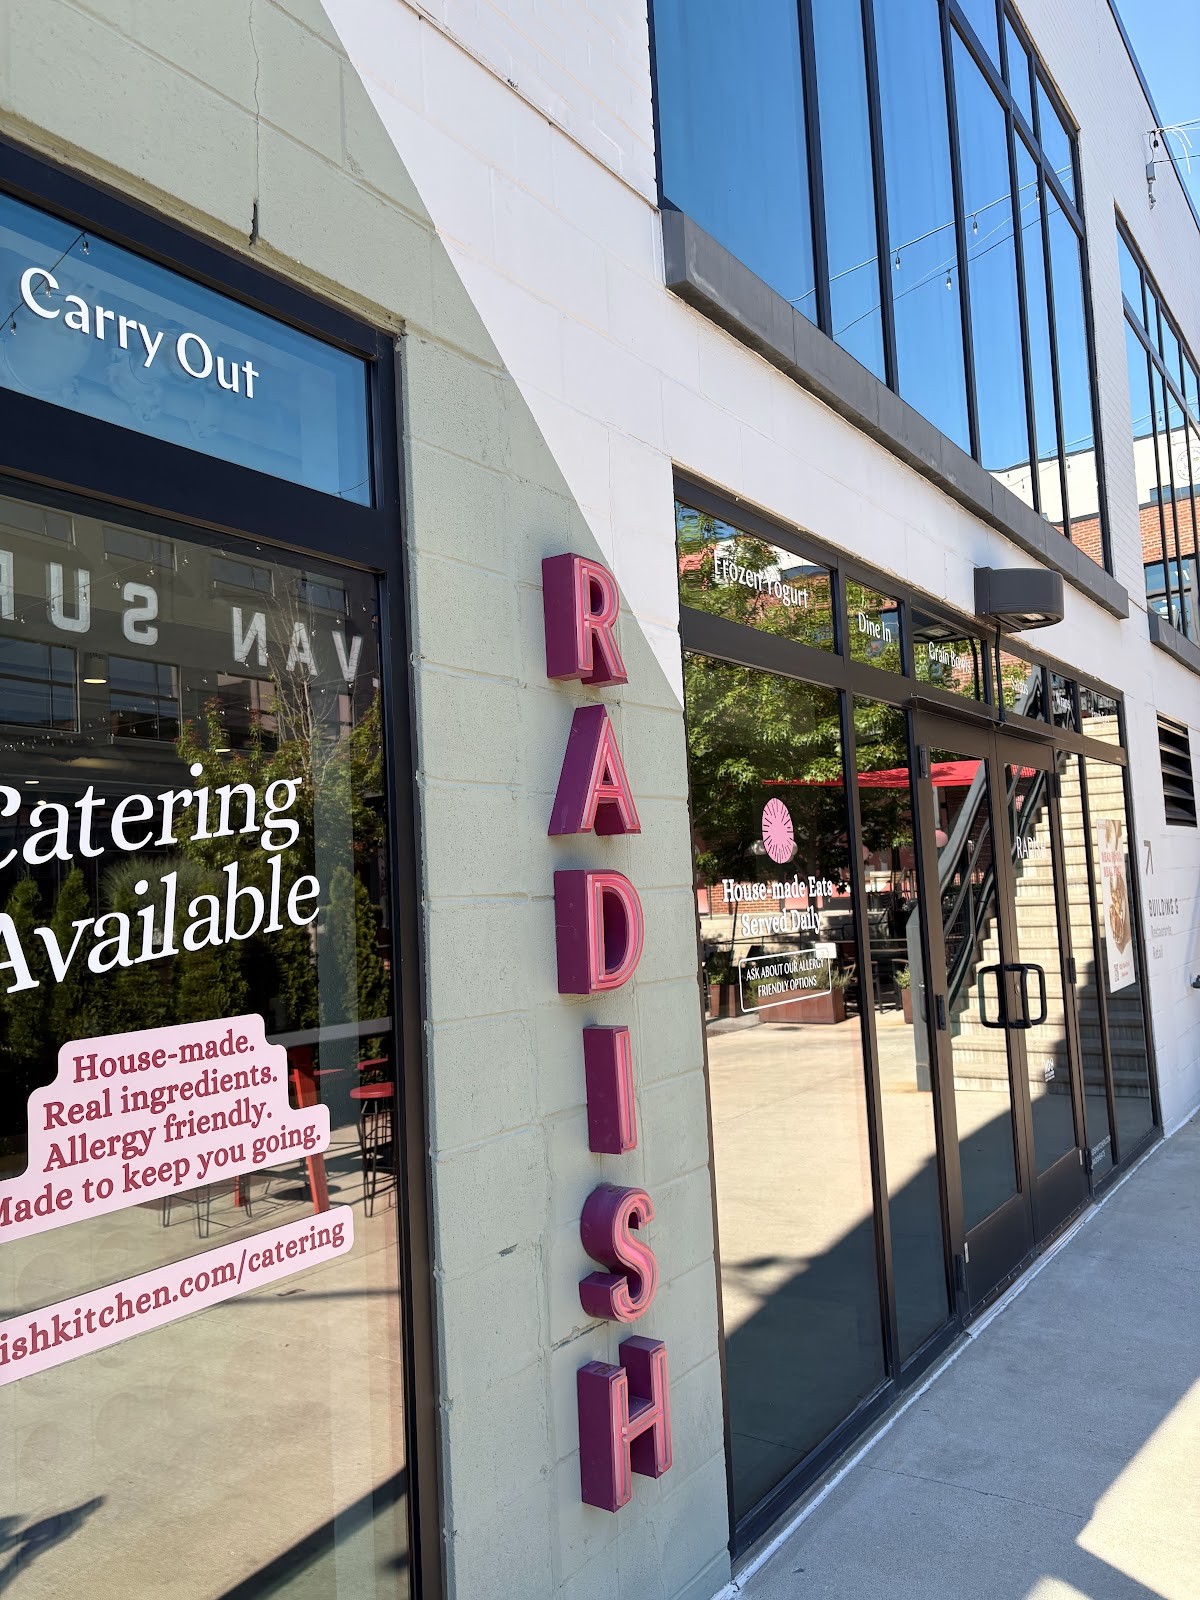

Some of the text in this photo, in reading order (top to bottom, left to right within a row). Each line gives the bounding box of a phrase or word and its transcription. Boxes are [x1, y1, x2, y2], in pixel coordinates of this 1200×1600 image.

[20, 267, 259, 399] Carry Out
[714, 549, 808, 609] Frozen Yogurt
[858, 612, 892, 643] Dine In
[929, 641, 972, 674] Grain Bowls
[722, 874, 833, 903] House-made Eats
[1149, 898, 1173, 917] BUILDING
[742, 905, 820, 937] Served Daily
[746, 957, 824, 982] ASK ABOUT OUR ALLERGY
[757, 975, 818, 998] FRIENDLY OPTIONS
[541, 552, 673, 1514] RADISH
[72, 1029, 255, 1084] House-made.
[43, 1065, 278, 1131] Real ingredients.
[43, 1097, 273, 1173] Allergy friendly.
[82, 1176, 114, 1204] to
[122, 1154, 190, 1194] keep
[197, 1143, 246, 1180] you
[252, 1123, 321, 1164] going.
